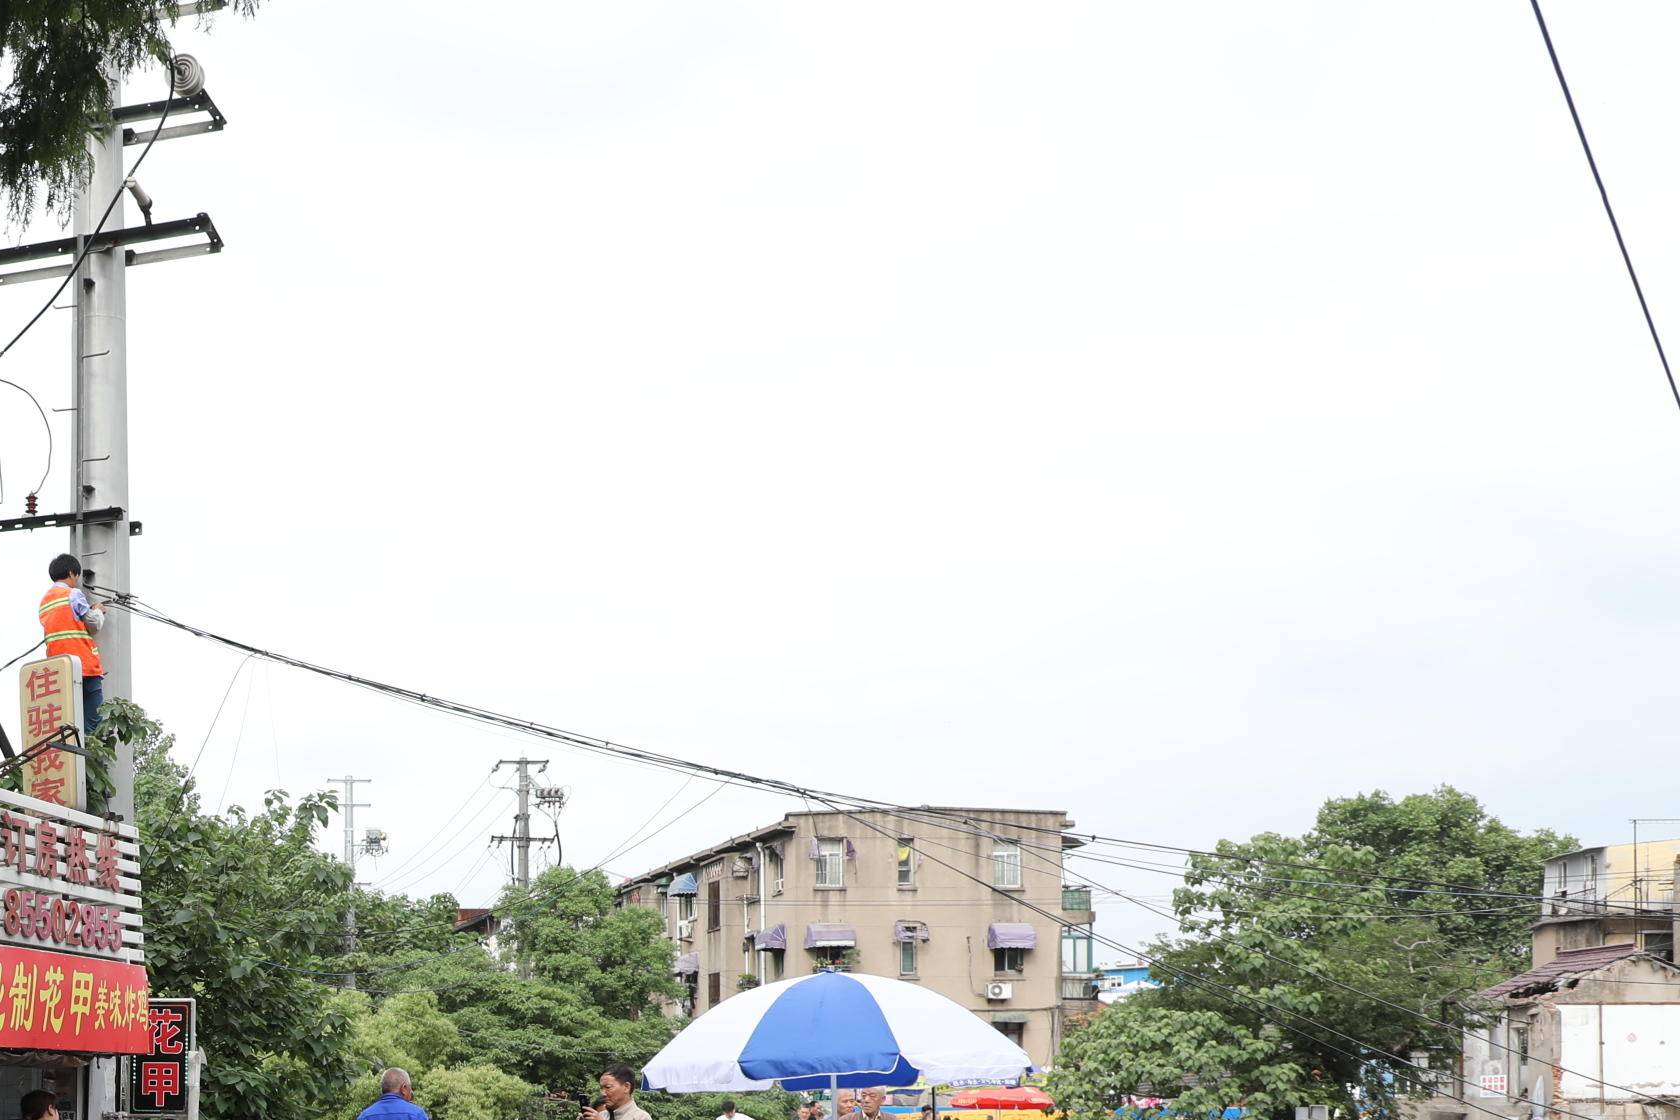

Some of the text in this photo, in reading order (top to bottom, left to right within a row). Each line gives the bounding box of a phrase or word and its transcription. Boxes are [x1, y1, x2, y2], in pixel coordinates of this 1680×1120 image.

[0, 811, 121, 892] 订房热线
[3, 887, 122, 951] 85502855
[94, 979, 149, 1032] 美味炸鸡
[142, 1008, 183, 1108] 花甲
